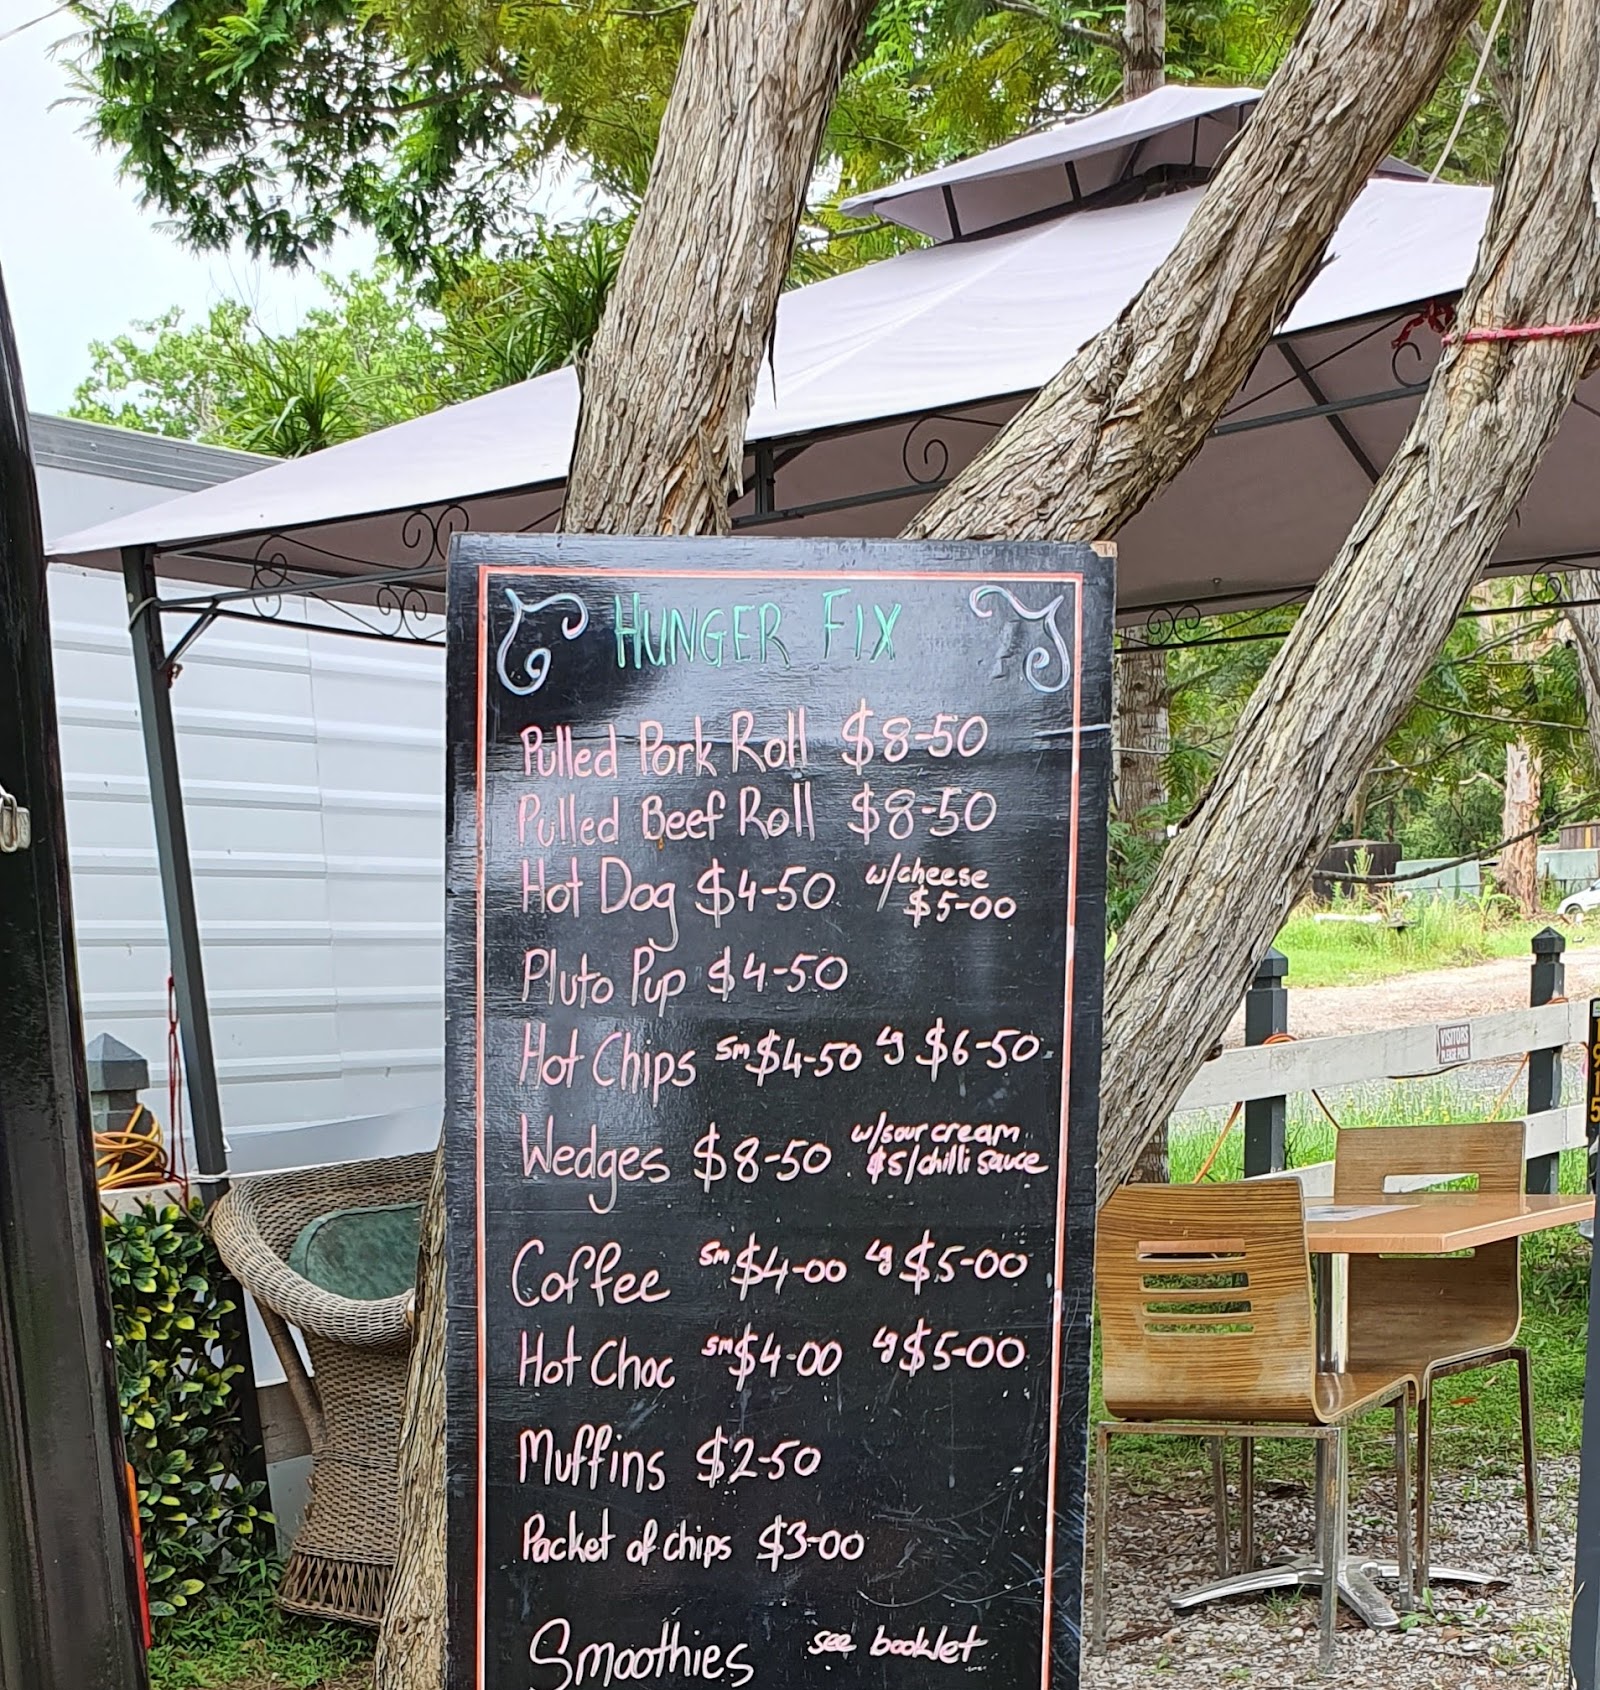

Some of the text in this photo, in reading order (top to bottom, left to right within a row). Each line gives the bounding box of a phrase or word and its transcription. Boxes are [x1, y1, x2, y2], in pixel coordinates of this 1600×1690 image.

[614, 587, 903, 670] HUNGER FIX
[520, 699, 989, 778] Pulled Pork Roll $8-50
[518, 782, 997, 848] Pulled Beef Roll $8-50
[521, 856, 837, 953] Hot Dog $4-50
[903, 884, 1017, 928] $5-00
[522, 947, 849, 1018] Pluto Pup $4-50
[519, 1022, 583, 1089] Hot
[593, 1030, 697, 1106] Chips
[746, 1029, 863, 1087] $4-50
[916, 1018, 1041, 1083] $6-50
[520, 1114, 832, 1215] Wedges $8-50
[930, 1122, 1021, 1147] cream
[512, 1239, 672, 1307] Coffee
[731, 1233, 848, 1301] $4-00
[899, 1230, 1029, 1296] $5-00
[519, 1325, 583, 1387] Hot
[591, 1325, 676, 1391] Choc
[733, 1322, 843, 1391] $4-00
[898, 1319, 1027, 1377] $5-00
[519, 1424, 822, 1492] Muffins $2-50
[522, 1509, 865, 1572] Packet of chips $3-00
[808, 1625, 988, 1664] see booklet
